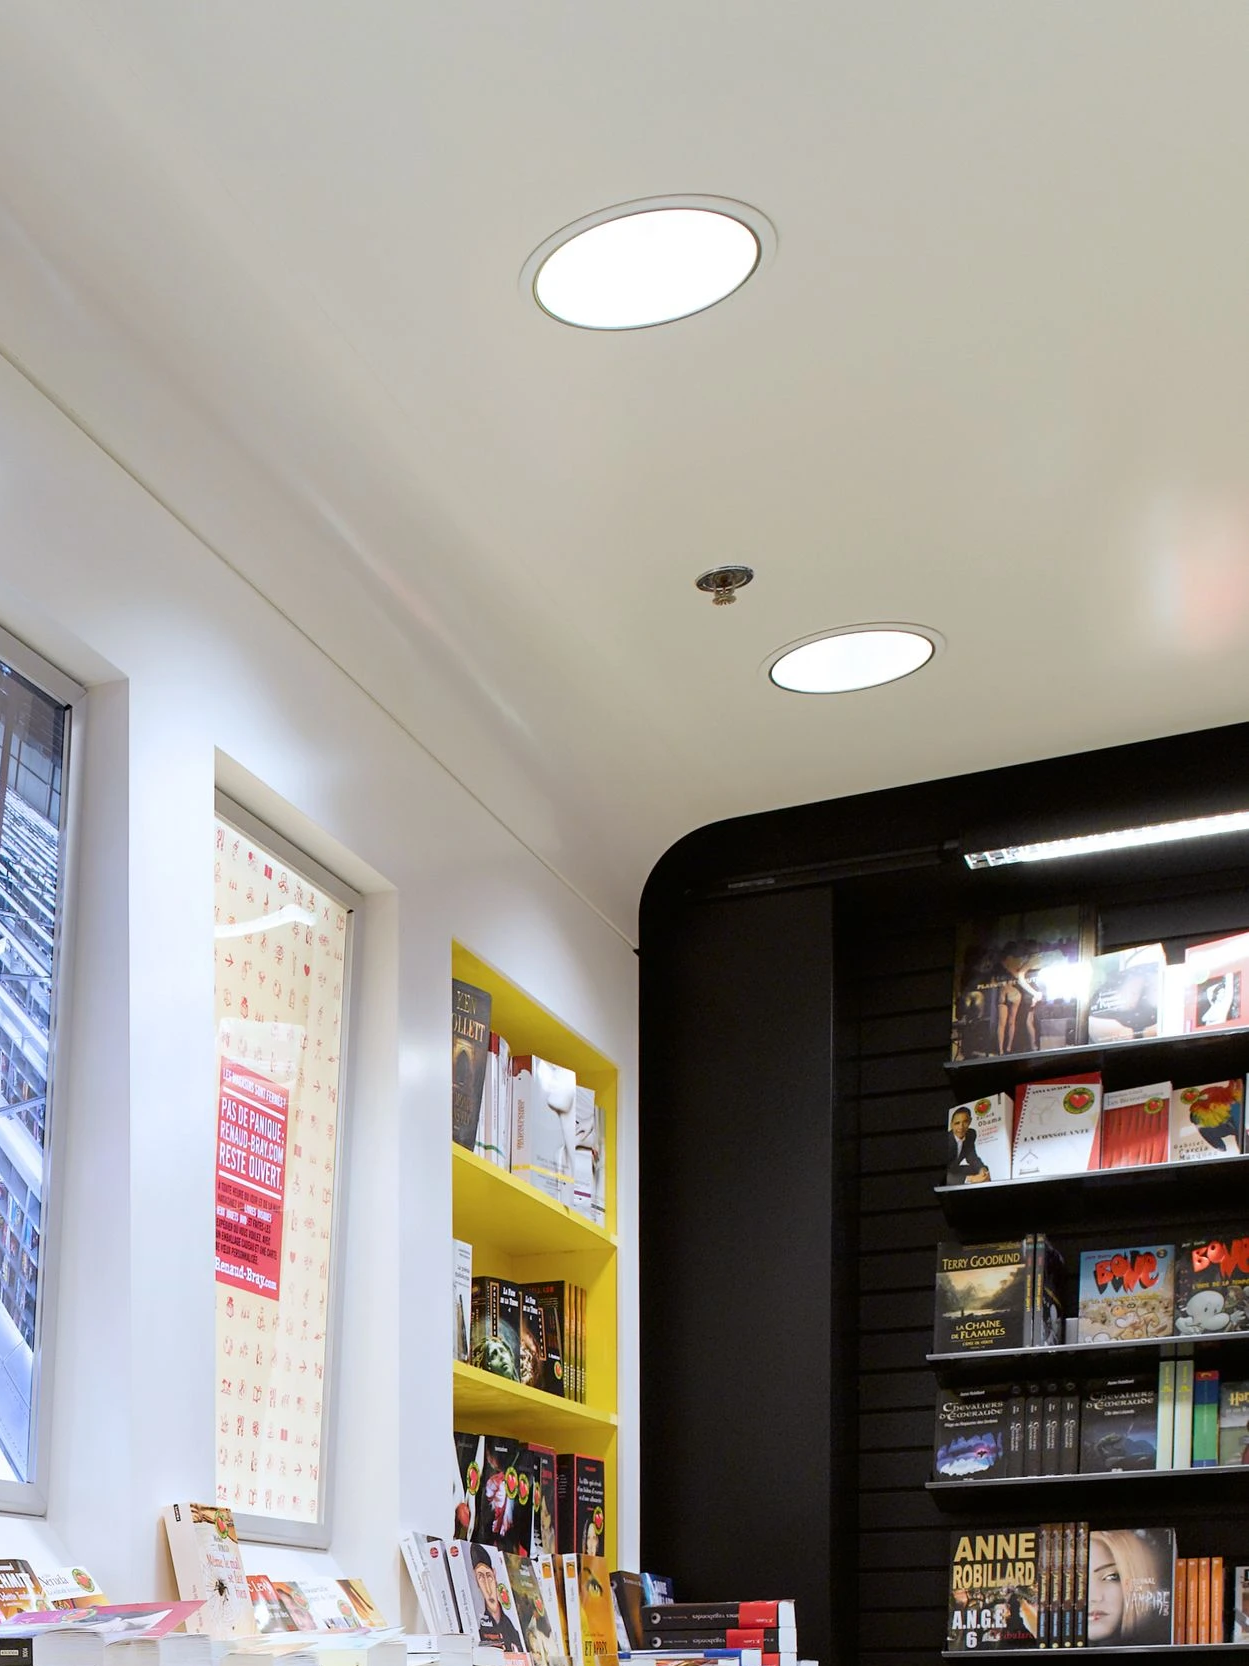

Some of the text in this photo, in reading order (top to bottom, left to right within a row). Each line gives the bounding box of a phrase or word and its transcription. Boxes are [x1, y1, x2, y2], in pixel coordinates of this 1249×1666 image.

[457, 991, 478, 1014] KEN
[221, 1096, 236, 1121] PAS
[238, 1105, 248, 1127] DE
[220, 1123, 283, 1164] RENAUD-BRAY.COM
[219, 1144, 282, 1189] RESTE OUVERT.
[215, 1256, 277, 1290] Renaud-Bray.com
[942, 1253, 1020, 1270] TERRY GOODKIND
[961, 1328, 1005, 1339] FLAMMES
[965, 1320, 1001, 1331] CHAÎNE
[953, 1532, 1035, 1562] ANNE
[952, 1562, 1035, 1589] ROBILLARD
[952, 1607, 1007, 1630] A.N.G.E.
[966, 1631, 977, 1648] 6
